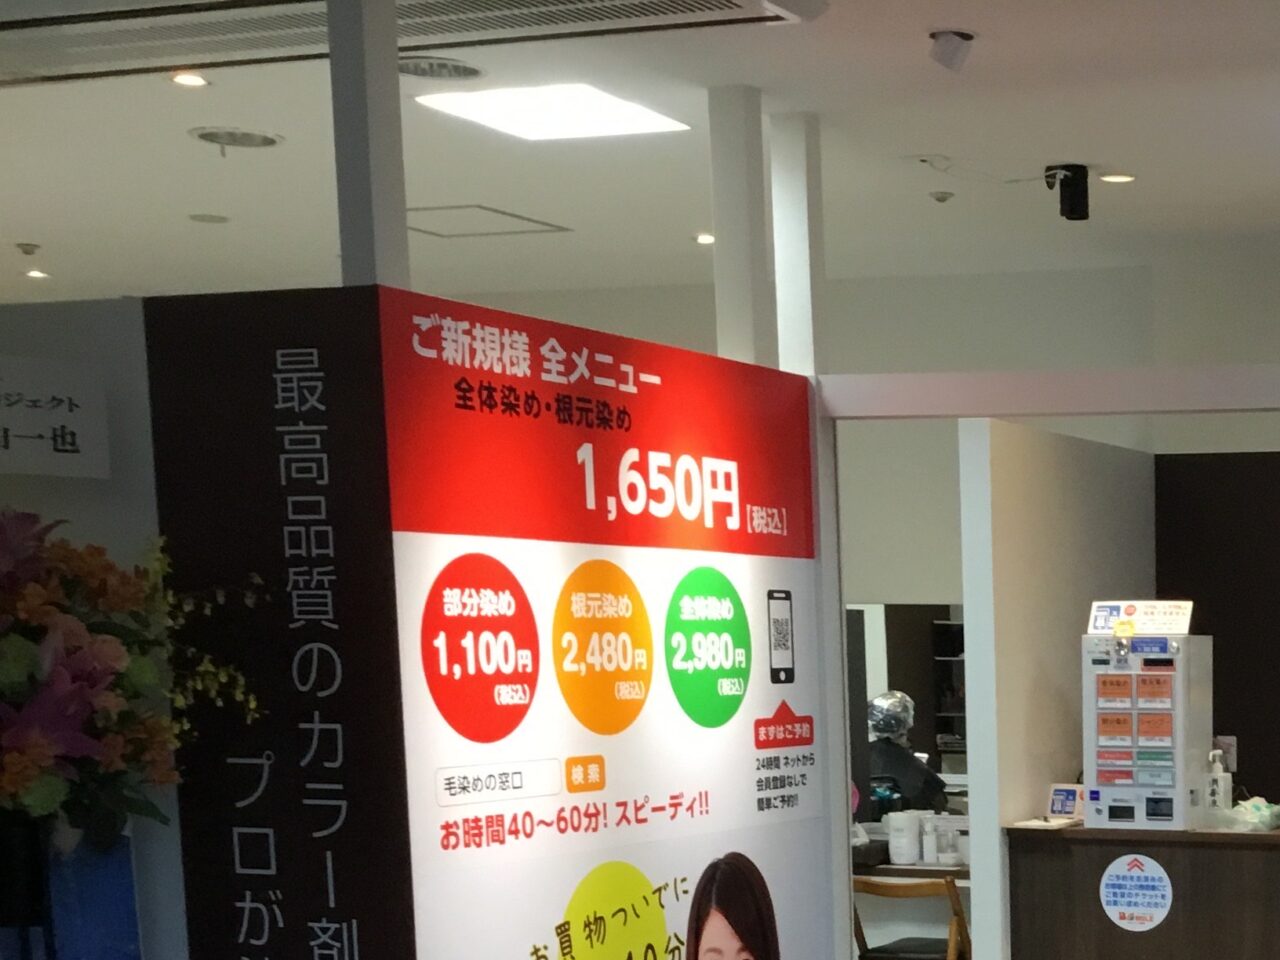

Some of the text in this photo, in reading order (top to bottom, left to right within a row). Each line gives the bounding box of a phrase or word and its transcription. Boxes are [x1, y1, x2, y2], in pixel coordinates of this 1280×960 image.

[412, 314, 662, 394] ご新規様 全メニュー
[454, 376, 632, 433] 全体染め・根元染め
[576, 442, 740, 531] 1,650円
[443, 588, 515, 617] 部分染め
[571, 592, 632, 619] 根元染め
[433, 630, 532, 680] 1,100円
[561, 631, 648, 674] 2,480円
[671, 631, 745, 671] 2,980円
[758, 722, 811, 741] まずはご予約
[443, 771, 523, 795] 毛染めの窓口
